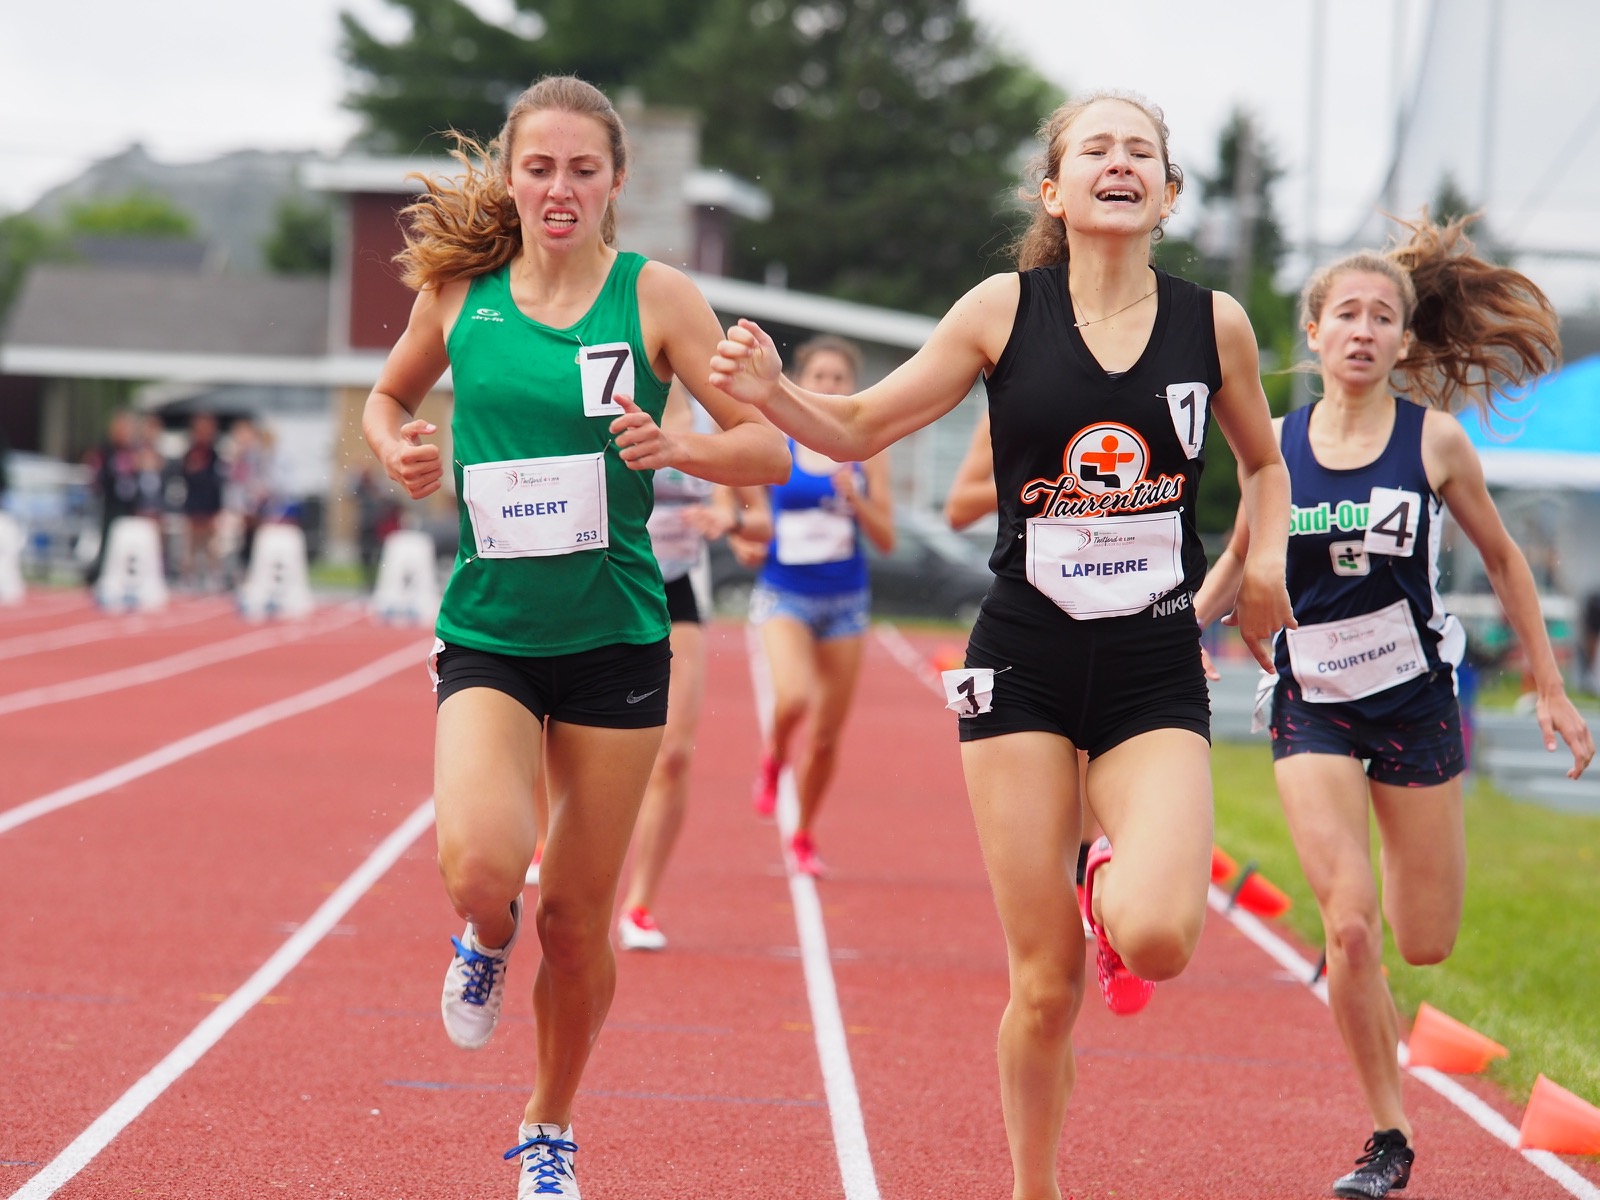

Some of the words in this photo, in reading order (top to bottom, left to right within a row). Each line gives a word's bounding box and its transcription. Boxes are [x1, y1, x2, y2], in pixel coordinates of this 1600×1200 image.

[586, 349, 629, 404] 7
[1180, 390, 1198, 449] 1
[502, 500, 568, 519] HÉBERT
[1289, 502, 1370, 535] Sud-Ou
[576, 530, 598, 542] 253
[1371, 501, 1413, 547] 4
[1061, 558, 1148, 578] LAPIERRE
[1149, 589, 1171, 602] 31
[1152, 592, 1189, 619] NIKE
[1317, 641, 1396, 673] COURTEAU
[1396, 660, 1417, 675] 522
